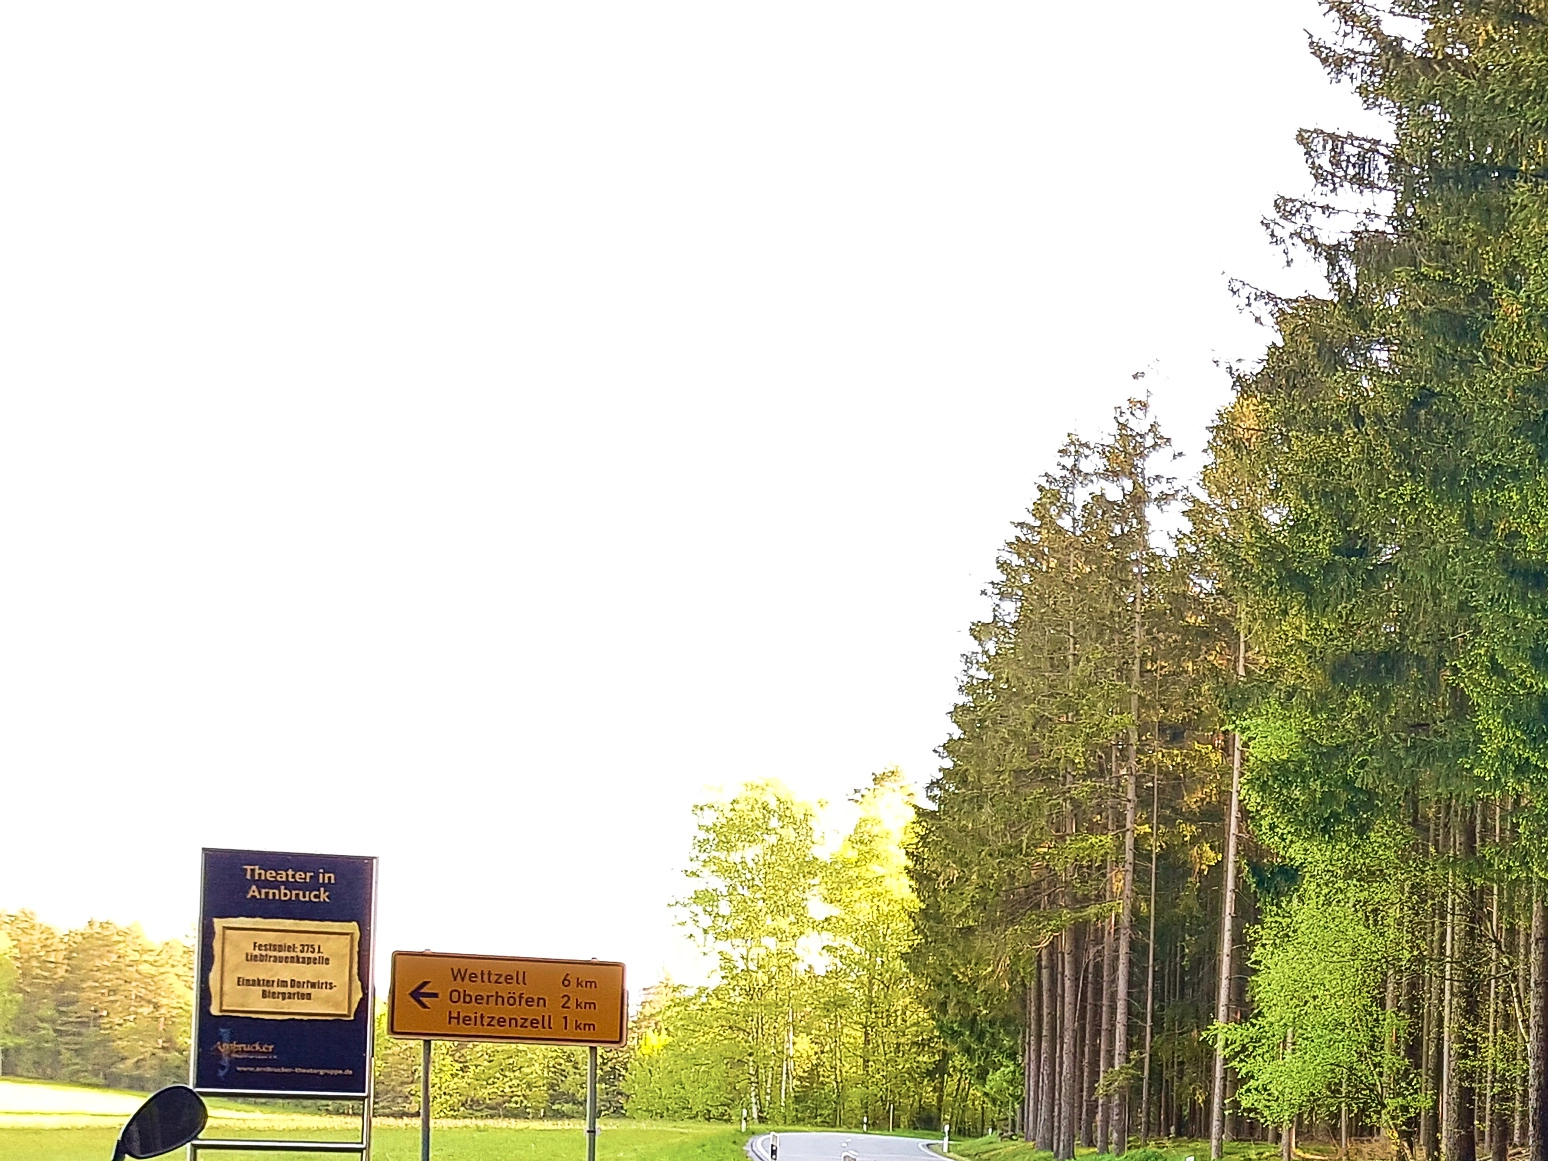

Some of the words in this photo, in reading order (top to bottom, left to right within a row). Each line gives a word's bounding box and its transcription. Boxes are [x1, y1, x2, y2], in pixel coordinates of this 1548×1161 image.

[243, 865, 314, 883] Theater
[319, 869, 336, 884] in
[246, 885, 331, 903] Arnbruck
[299, 944, 315, 954] 375
[245, 952, 330, 966] Liebfrauenkapelle
[236, 977, 275, 988] Einakter
[276, 978, 288, 988] im
[290, 979, 337, 991] Dorfwirts-
[450, 967, 527, 986] Wettzell
[561, 973, 571, 988] 6
[576, 977, 598, 989] km
[261, 989, 312, 1001] Biergarten
[448, 989, 547, 1008] Oberhöfen
[560, 994, 571, 1010] 2
[575, 998, 597, 1011] km
[447, 1010, 553, 1030] Heitzenzell
[561, 1015, 569, 1031] 1
[574, 1019, 596, 1031] km
